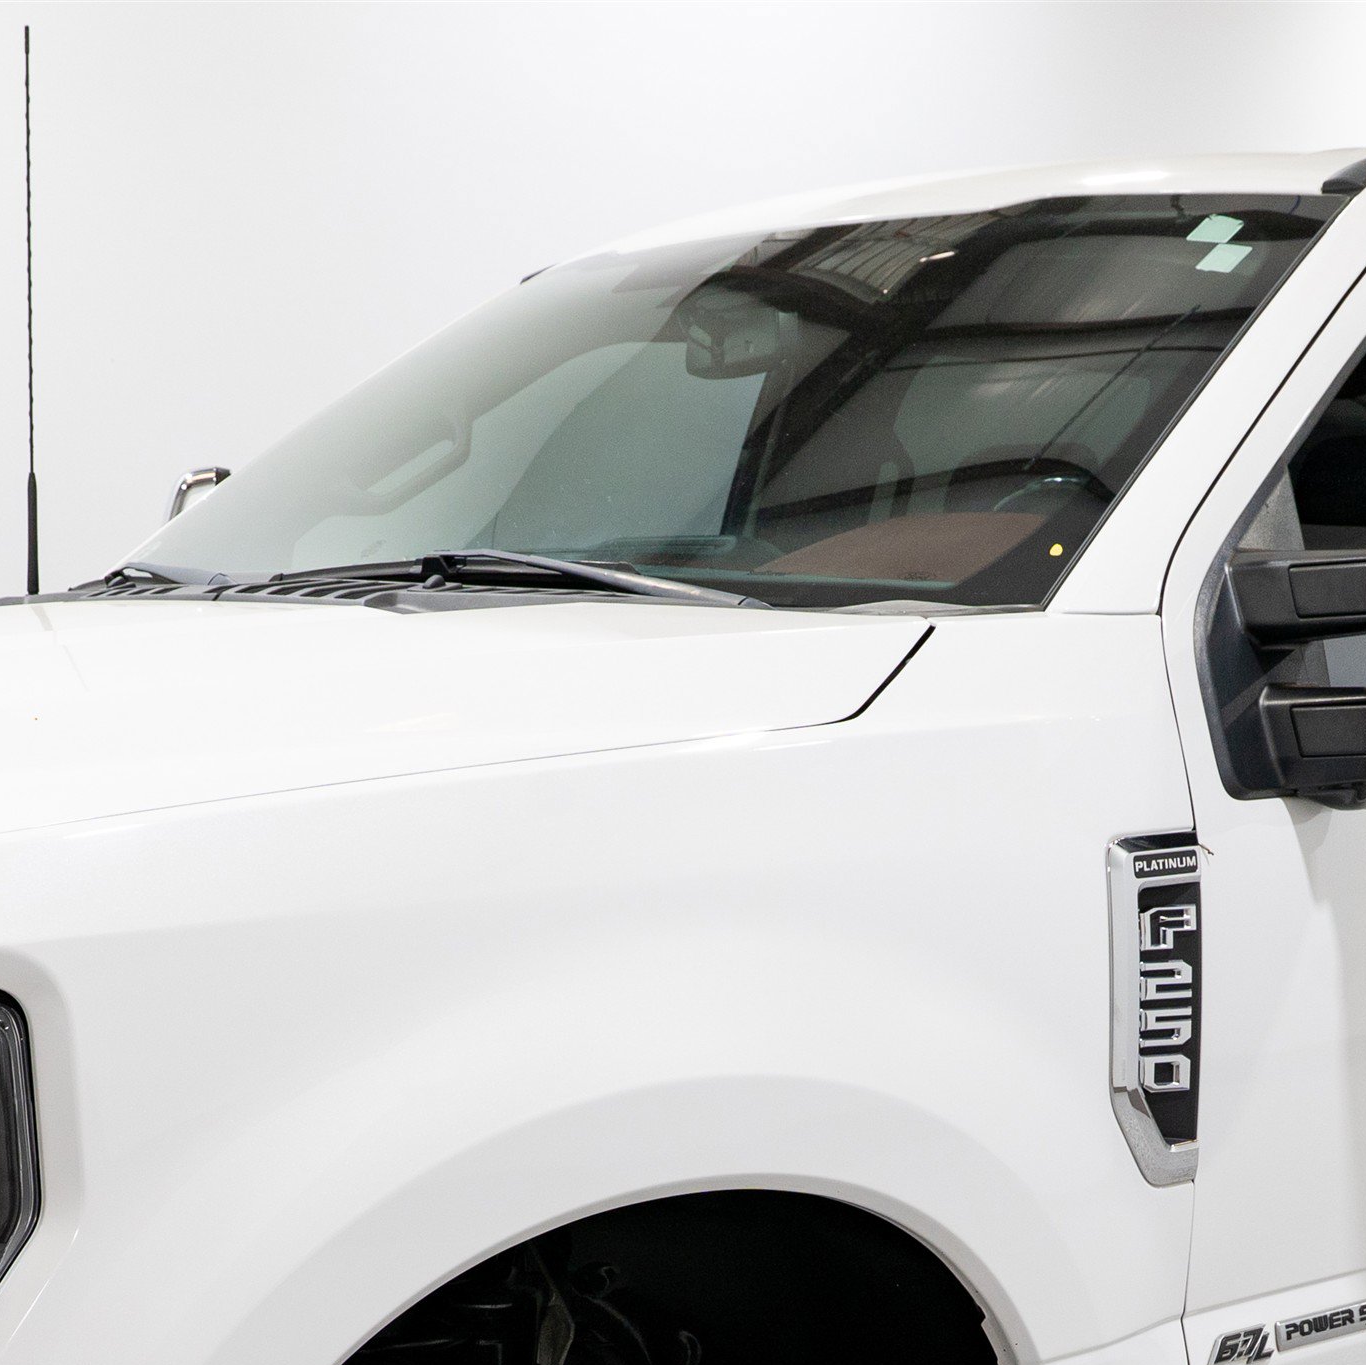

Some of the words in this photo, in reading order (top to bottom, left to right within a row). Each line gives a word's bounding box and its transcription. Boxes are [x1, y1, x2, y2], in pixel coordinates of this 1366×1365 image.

[1135, 855, 1196, 873] PLATINUM
[1138, 905, 1197, 1093] F250
[1285, 1309, 1354, 1341] POWER
